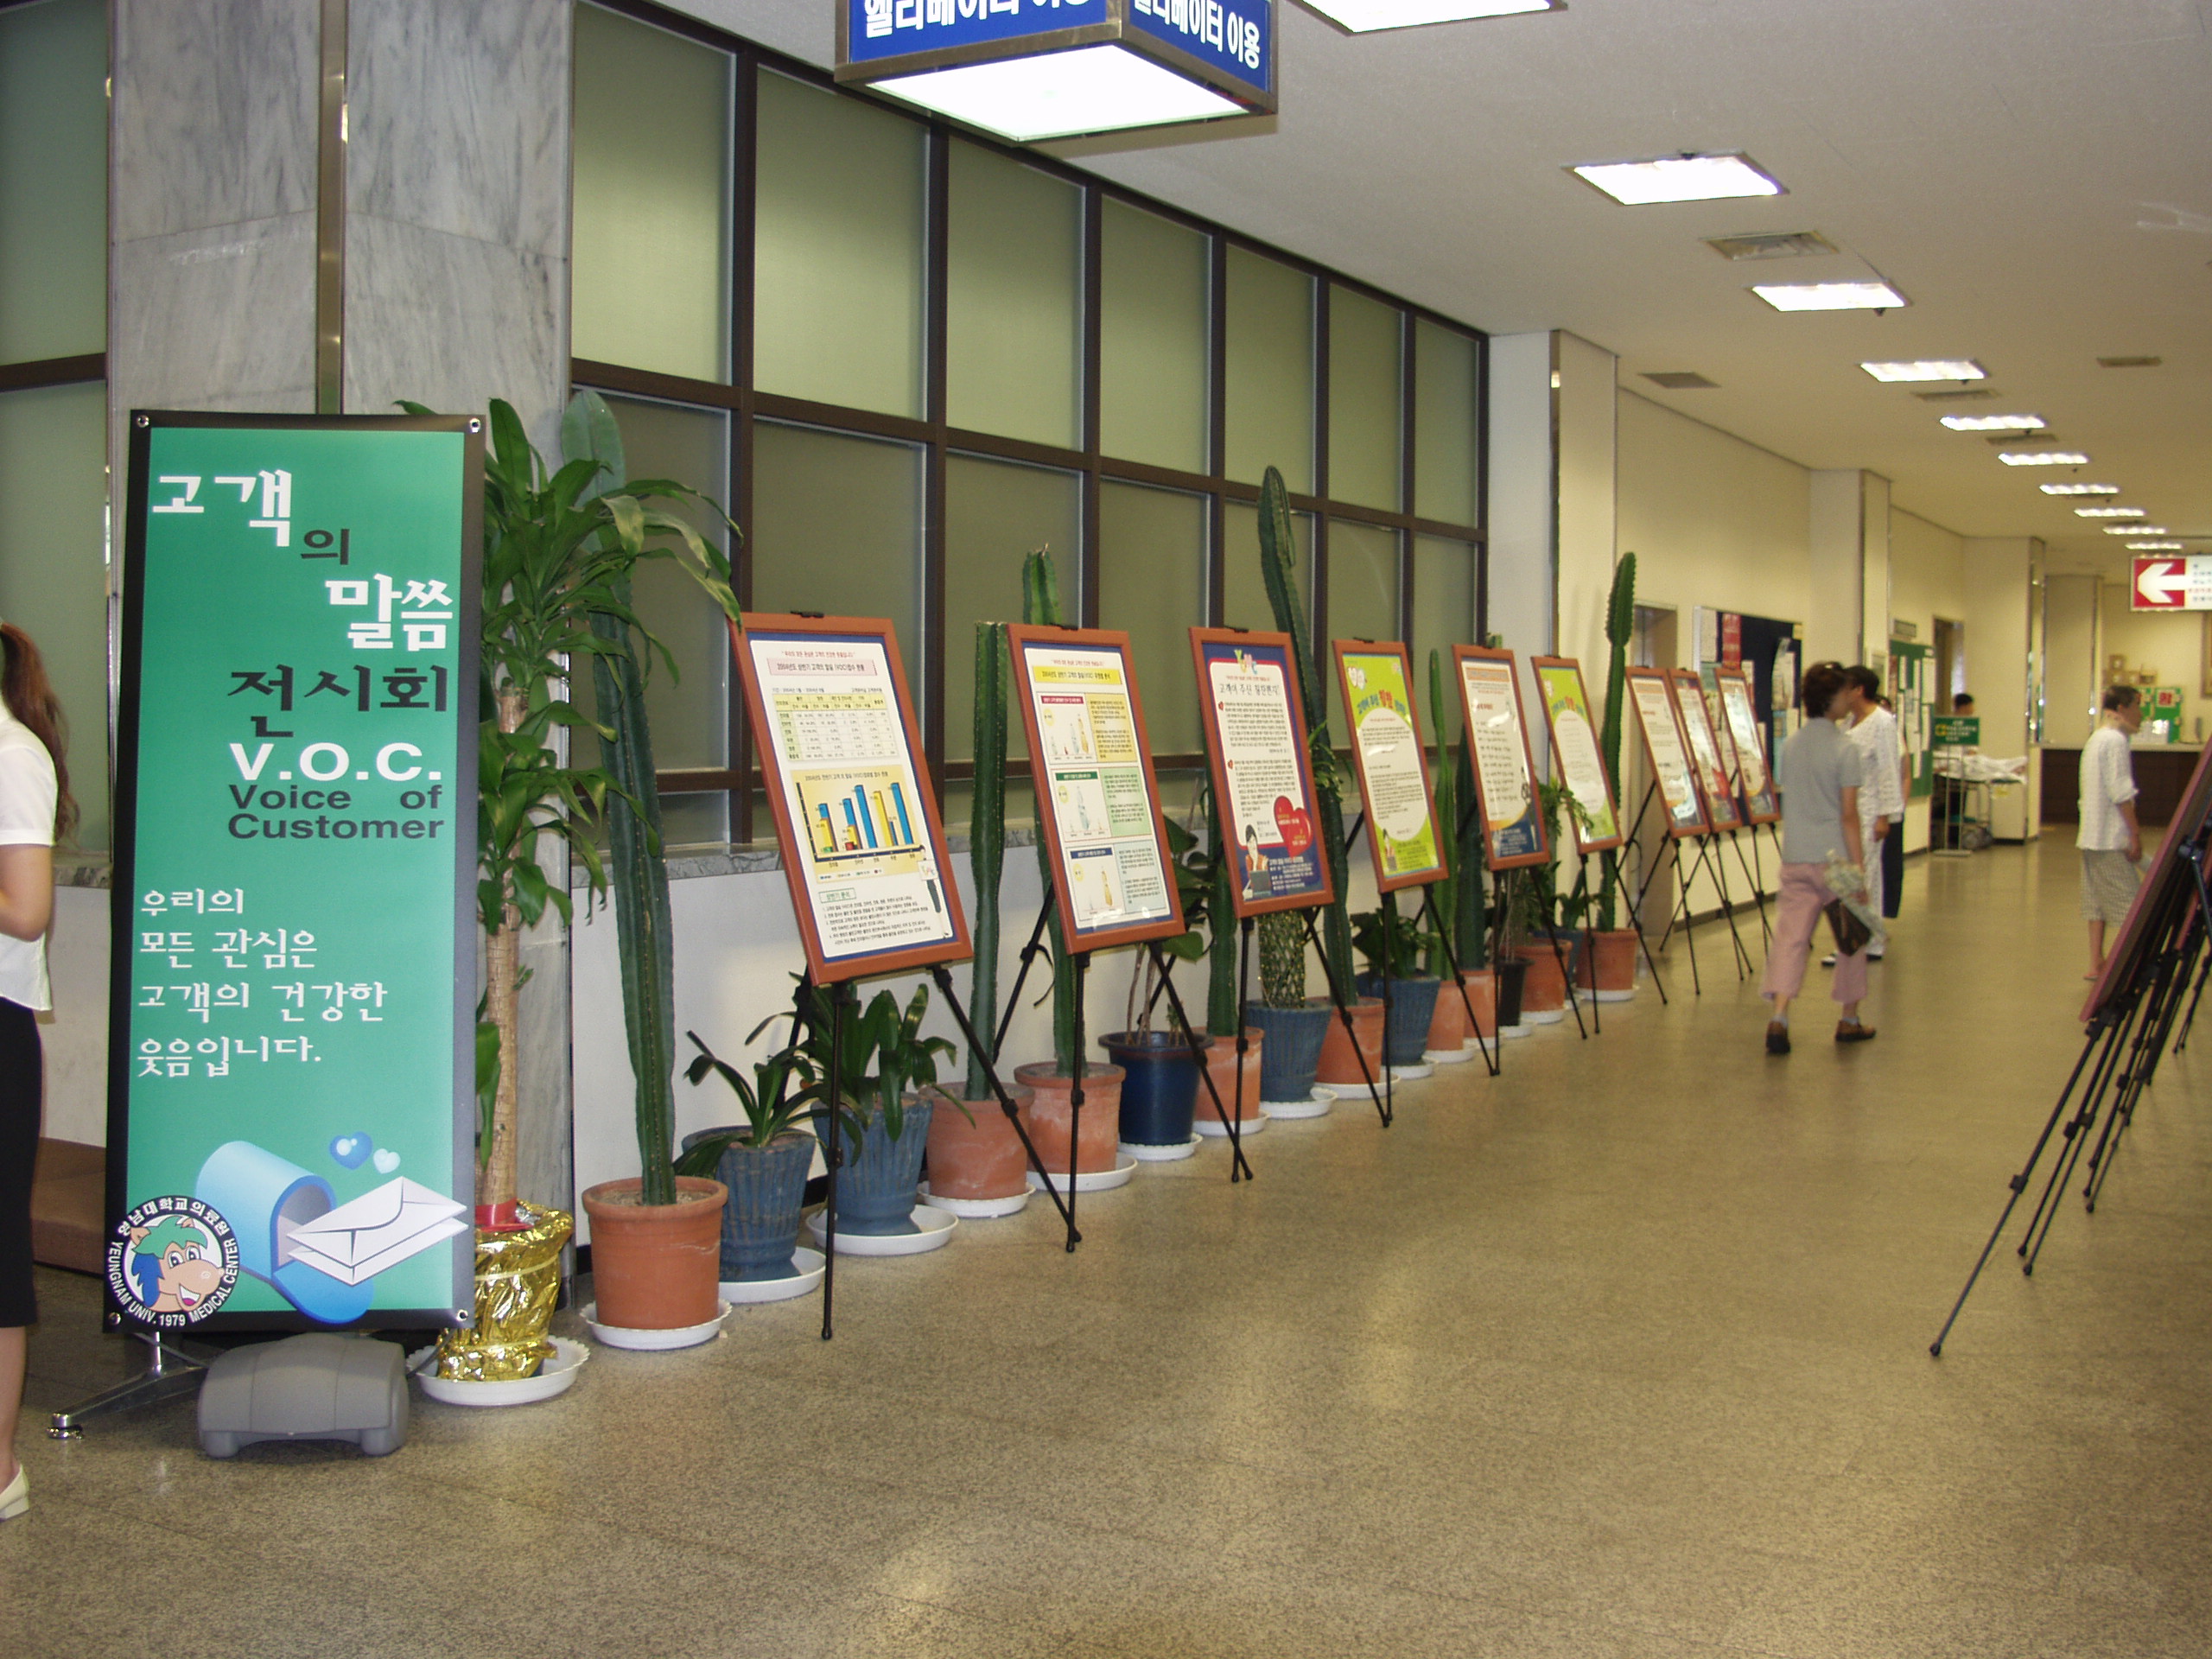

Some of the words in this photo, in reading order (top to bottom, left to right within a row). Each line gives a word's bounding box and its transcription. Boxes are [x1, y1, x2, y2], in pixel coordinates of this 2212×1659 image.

[1227, 11, 1260, 69] 이용
[325, 573, 453, 652] 말씀
[227, 664, 448, 737] 전시회
[229, 742, 442, 780] V.O.C.
[229, 784, 352, 810] Voice
[399, 784, 443, 810] of
[228, 813, 445, 839] Customer
[140, 888, 244, 916] 우리의
[140, 931, 195, 969] 모든
[212, 928, 317, 969] 관심은
[138, 982, 249, 1023] 고객의
[271, 982, 388, 1022] 건강한
[137, 1036, 321, 1077] 웃음입니다.
[109, 1241, 130, 1306] YEUNGNAM
[128, 1303, 156, 1325] UNIV.
[159, 1313, 186, 1327] 1979
[188, 1286, 232, 1323] MEDICAL
[223, 1237, 239, 1284] CENTER
